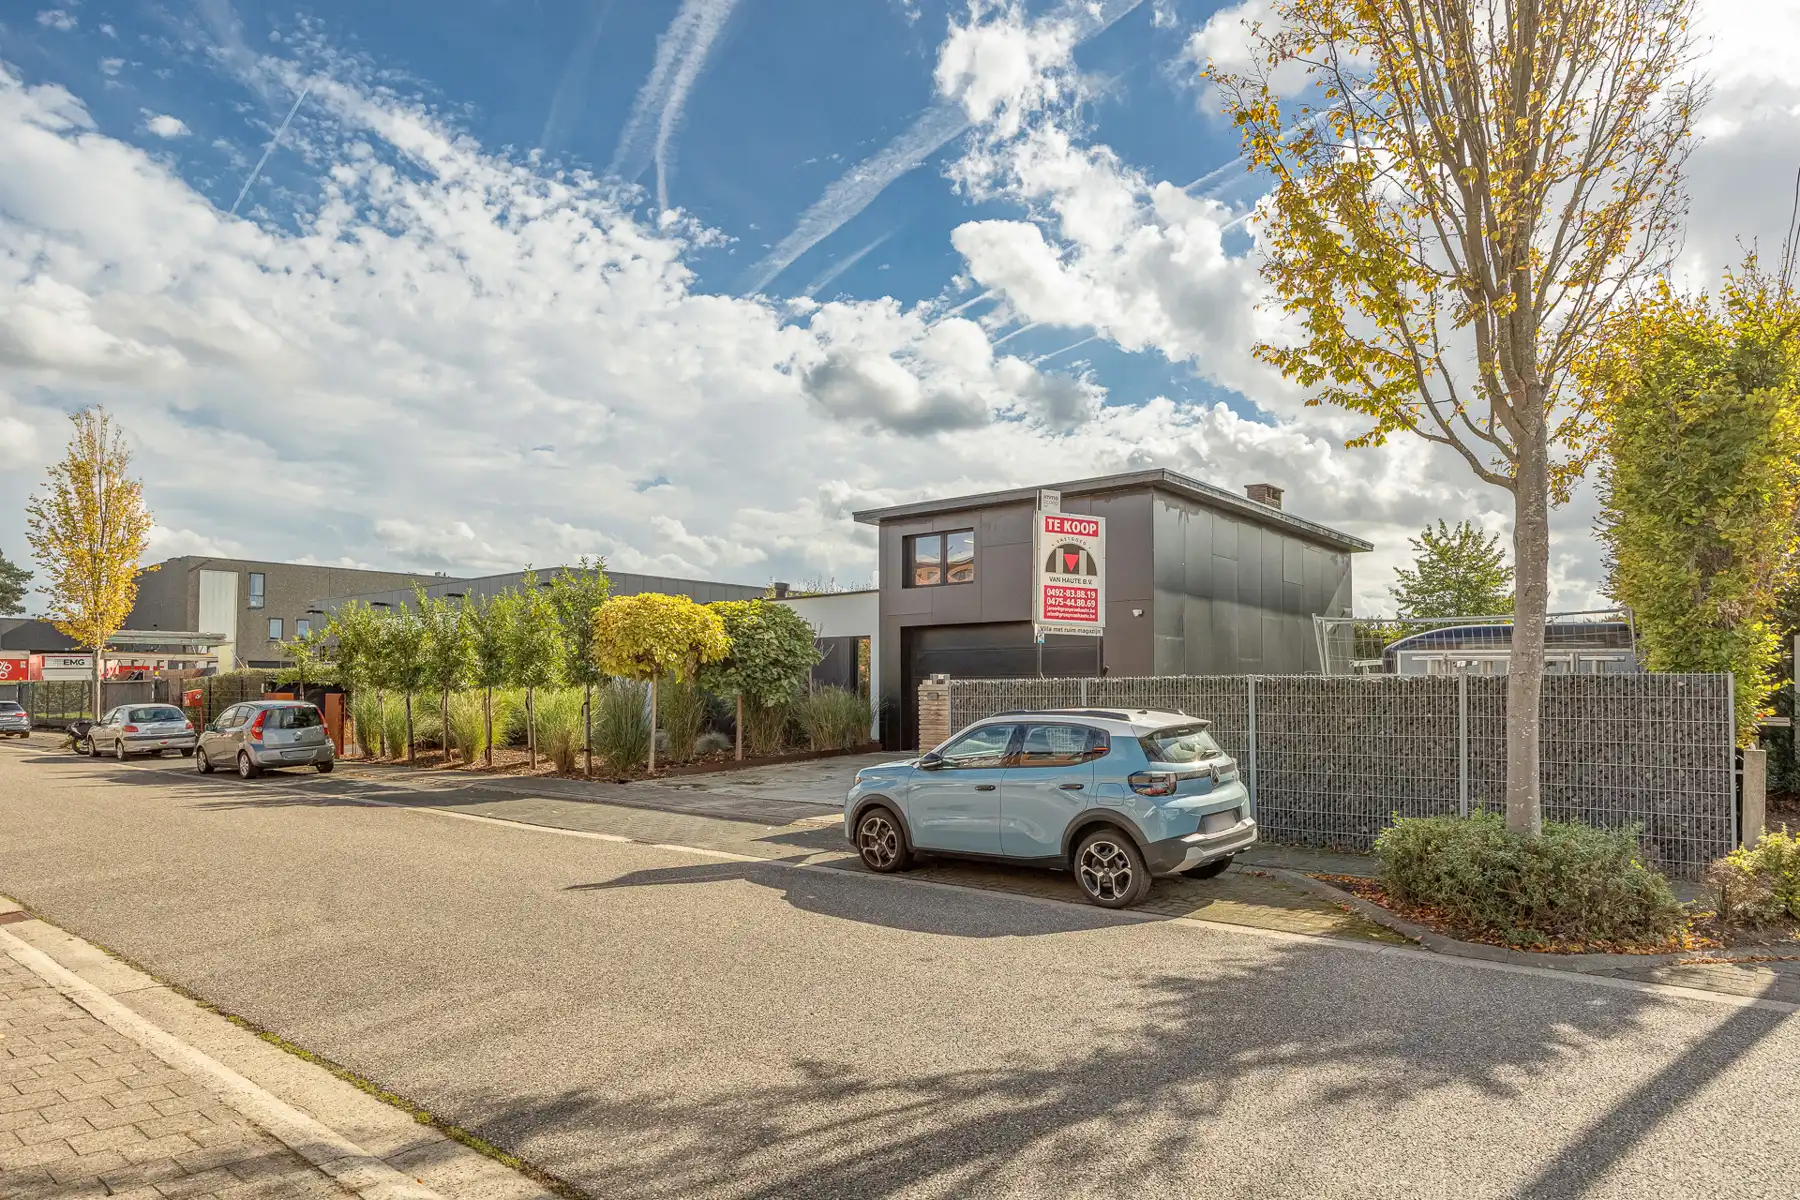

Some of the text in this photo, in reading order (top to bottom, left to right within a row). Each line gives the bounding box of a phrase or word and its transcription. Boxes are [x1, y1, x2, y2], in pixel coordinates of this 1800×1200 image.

[1047, 518, 1097, 534] TE KOOP
[1061, 576, 1082, 584] HAUTE
[1046, 588, 1096, 599] 0492-83.88.19
[1046, 597, 1096, 608] 0475-44.80.69
[63, 658, 85, 666] EMG
